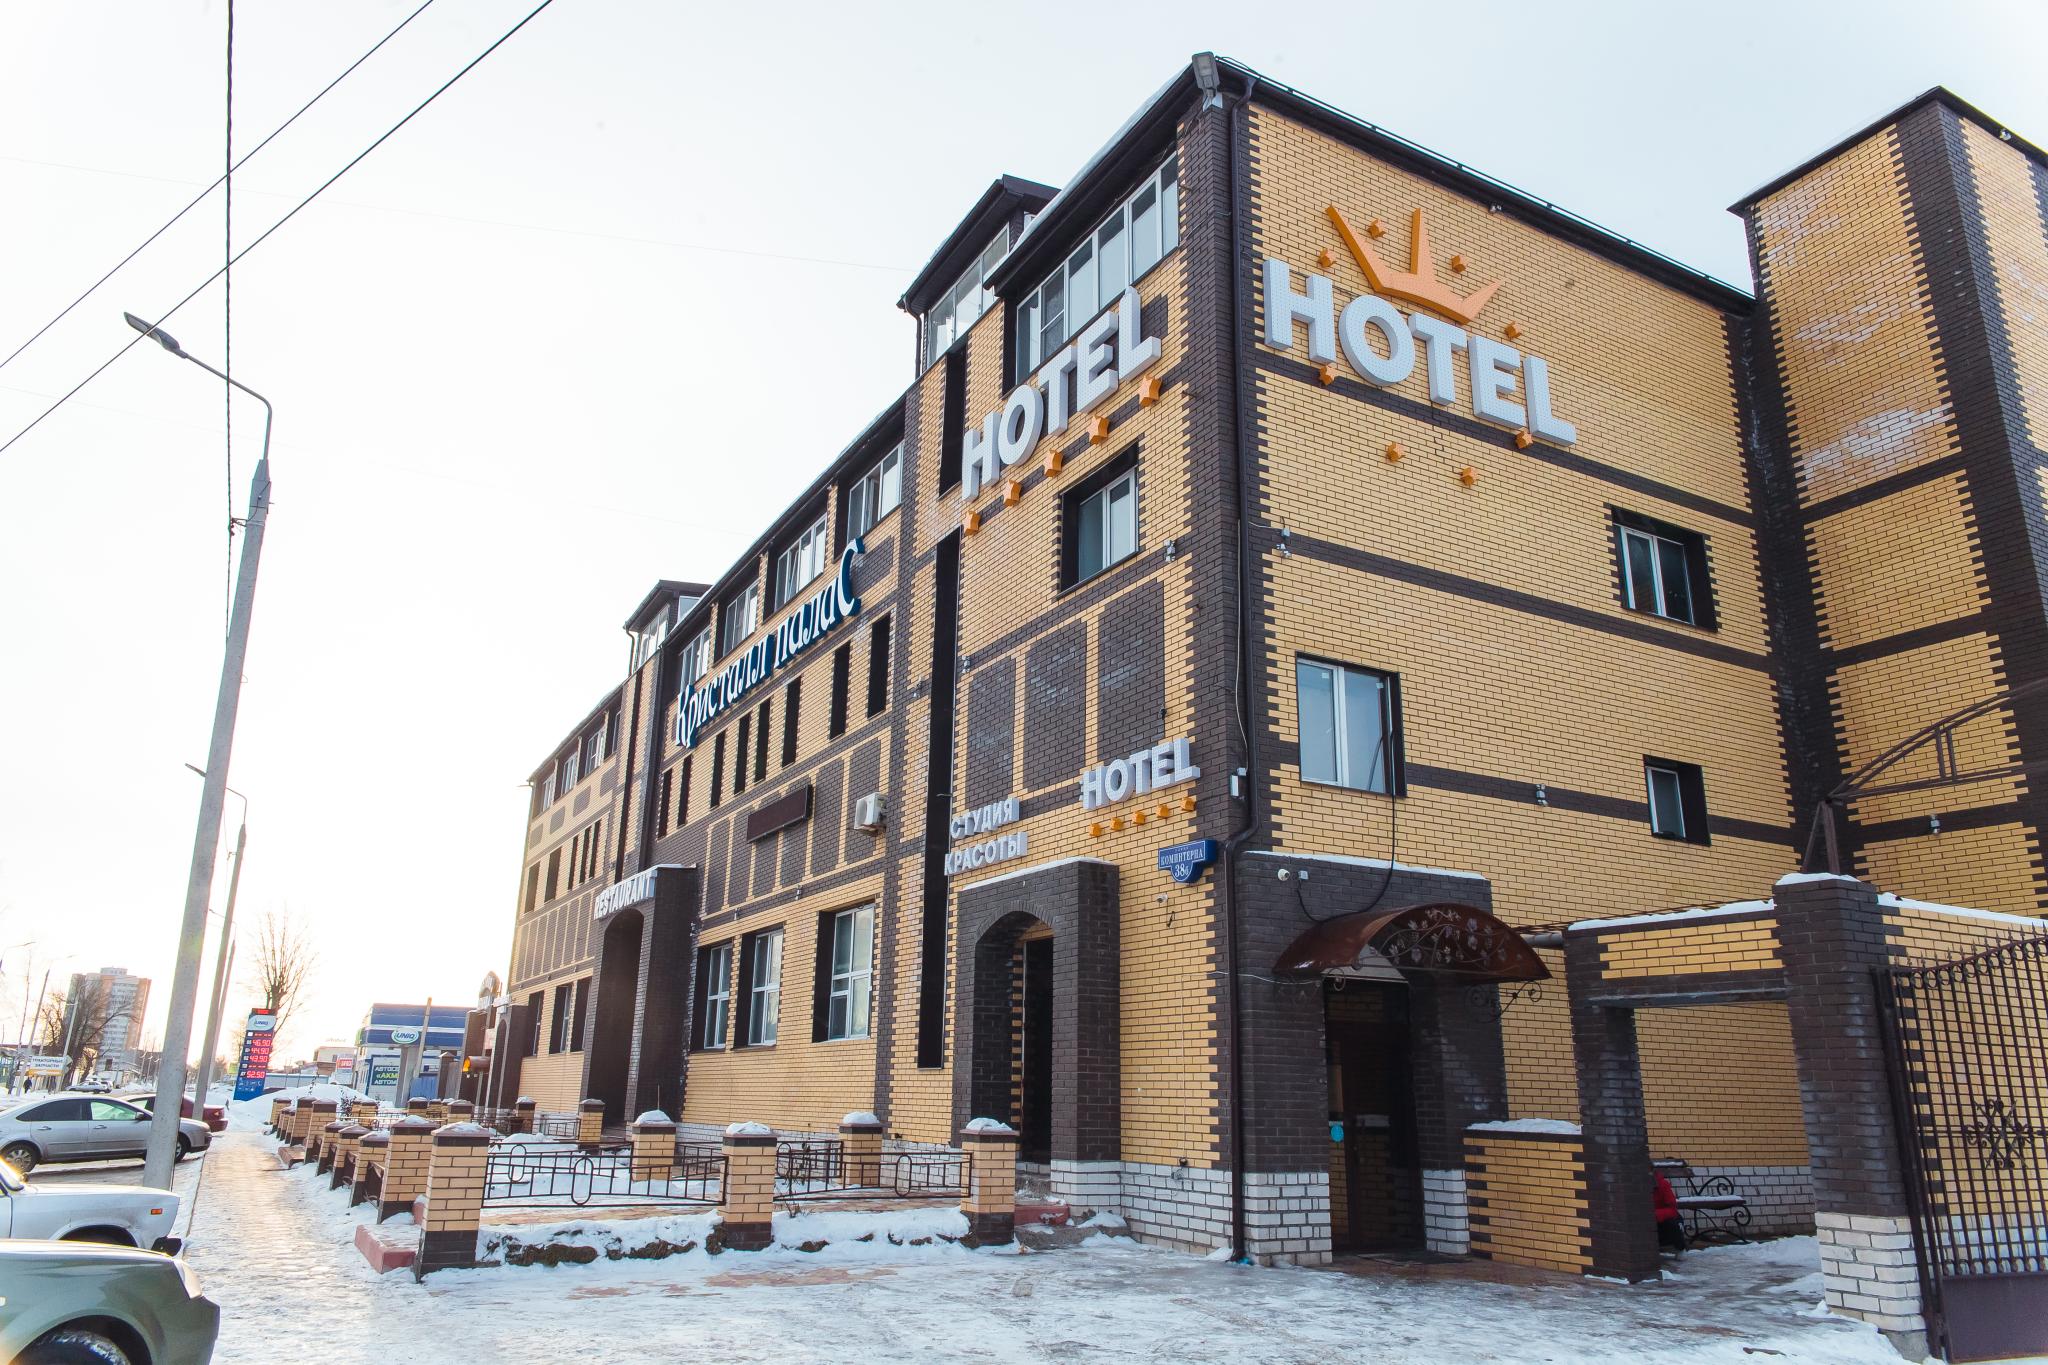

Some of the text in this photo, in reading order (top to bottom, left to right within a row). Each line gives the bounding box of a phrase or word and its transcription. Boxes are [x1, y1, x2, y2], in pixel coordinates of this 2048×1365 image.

[1262, 257, 1577, 447] HOTEL
[961, 286, 1162, 501] HOTEL
[1080, 738, 1200, 810] HOTEL
[950, 796, 1020, 839] СТУДИЯ
[944, 831, 1028, 876] КРАСОТЫ
[1160, 848, 1203, 866] КОМИНТЕРНА
[593, 869, 658, 920] RESTAURANT
[395, 1032, 416, 1040] UNIQ
